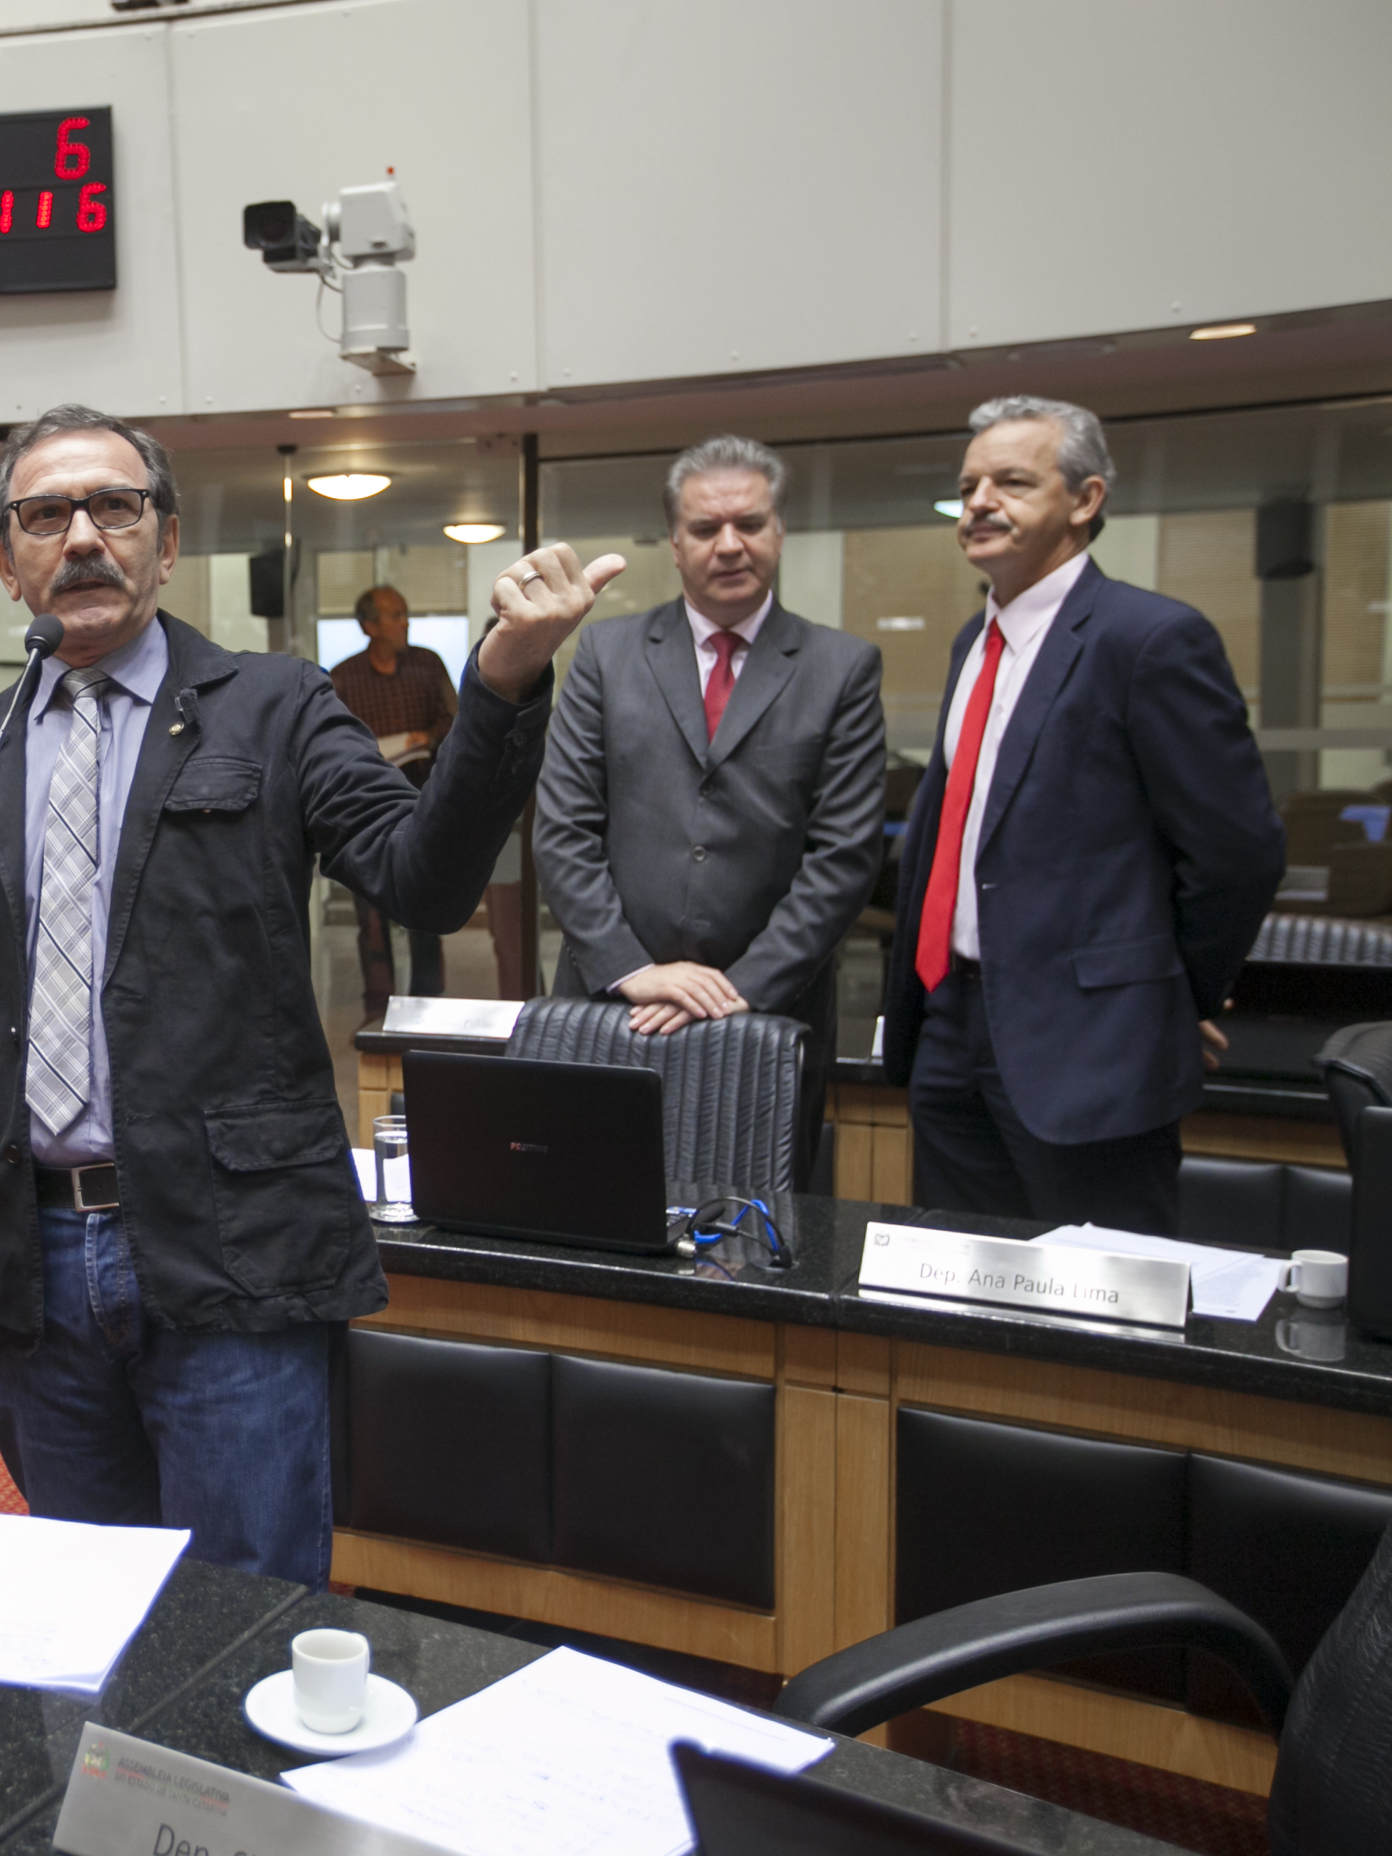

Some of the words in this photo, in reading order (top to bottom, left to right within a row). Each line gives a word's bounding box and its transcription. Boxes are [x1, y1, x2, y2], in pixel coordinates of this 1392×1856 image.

[919, 1262, 961, 1286] Dep.
[968, 1268, 1006, 1290] Ana
[1012, 1273, 1065, 1297] Paula
[1072, 1282, 1120, 1304] Lima
[117, 1757, 172, 1783] ASSEMBLEIA
[173, 1774, 231, 1804] LEGISLATIVA
